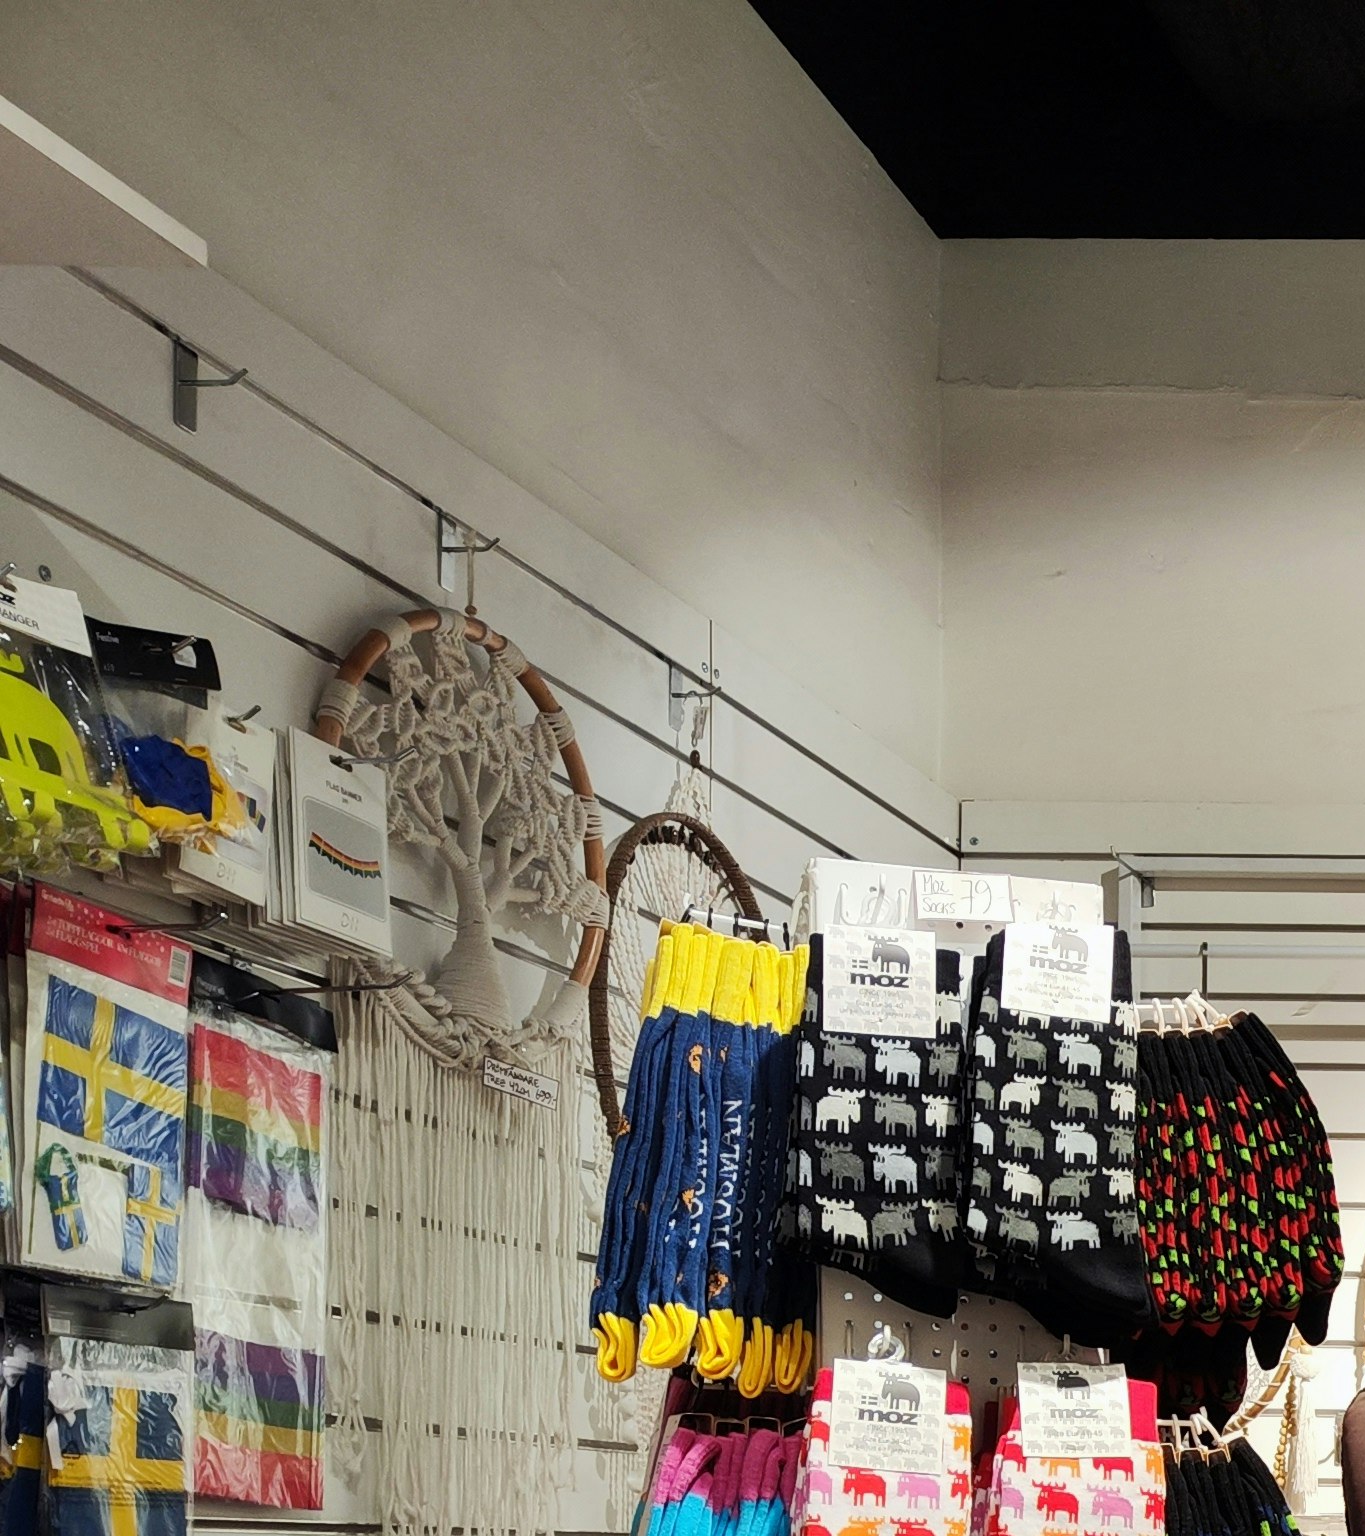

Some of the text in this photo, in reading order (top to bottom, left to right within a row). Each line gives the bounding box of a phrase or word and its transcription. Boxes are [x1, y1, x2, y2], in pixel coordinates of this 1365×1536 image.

[0, 608, 40, 630] ANGER
[1030, 955, 1088, 975] moz
[850, 972, 910, 989] moz
[858, 1408, 918, 1426] moz
[1050, 1408, 1099, 1419] moz
